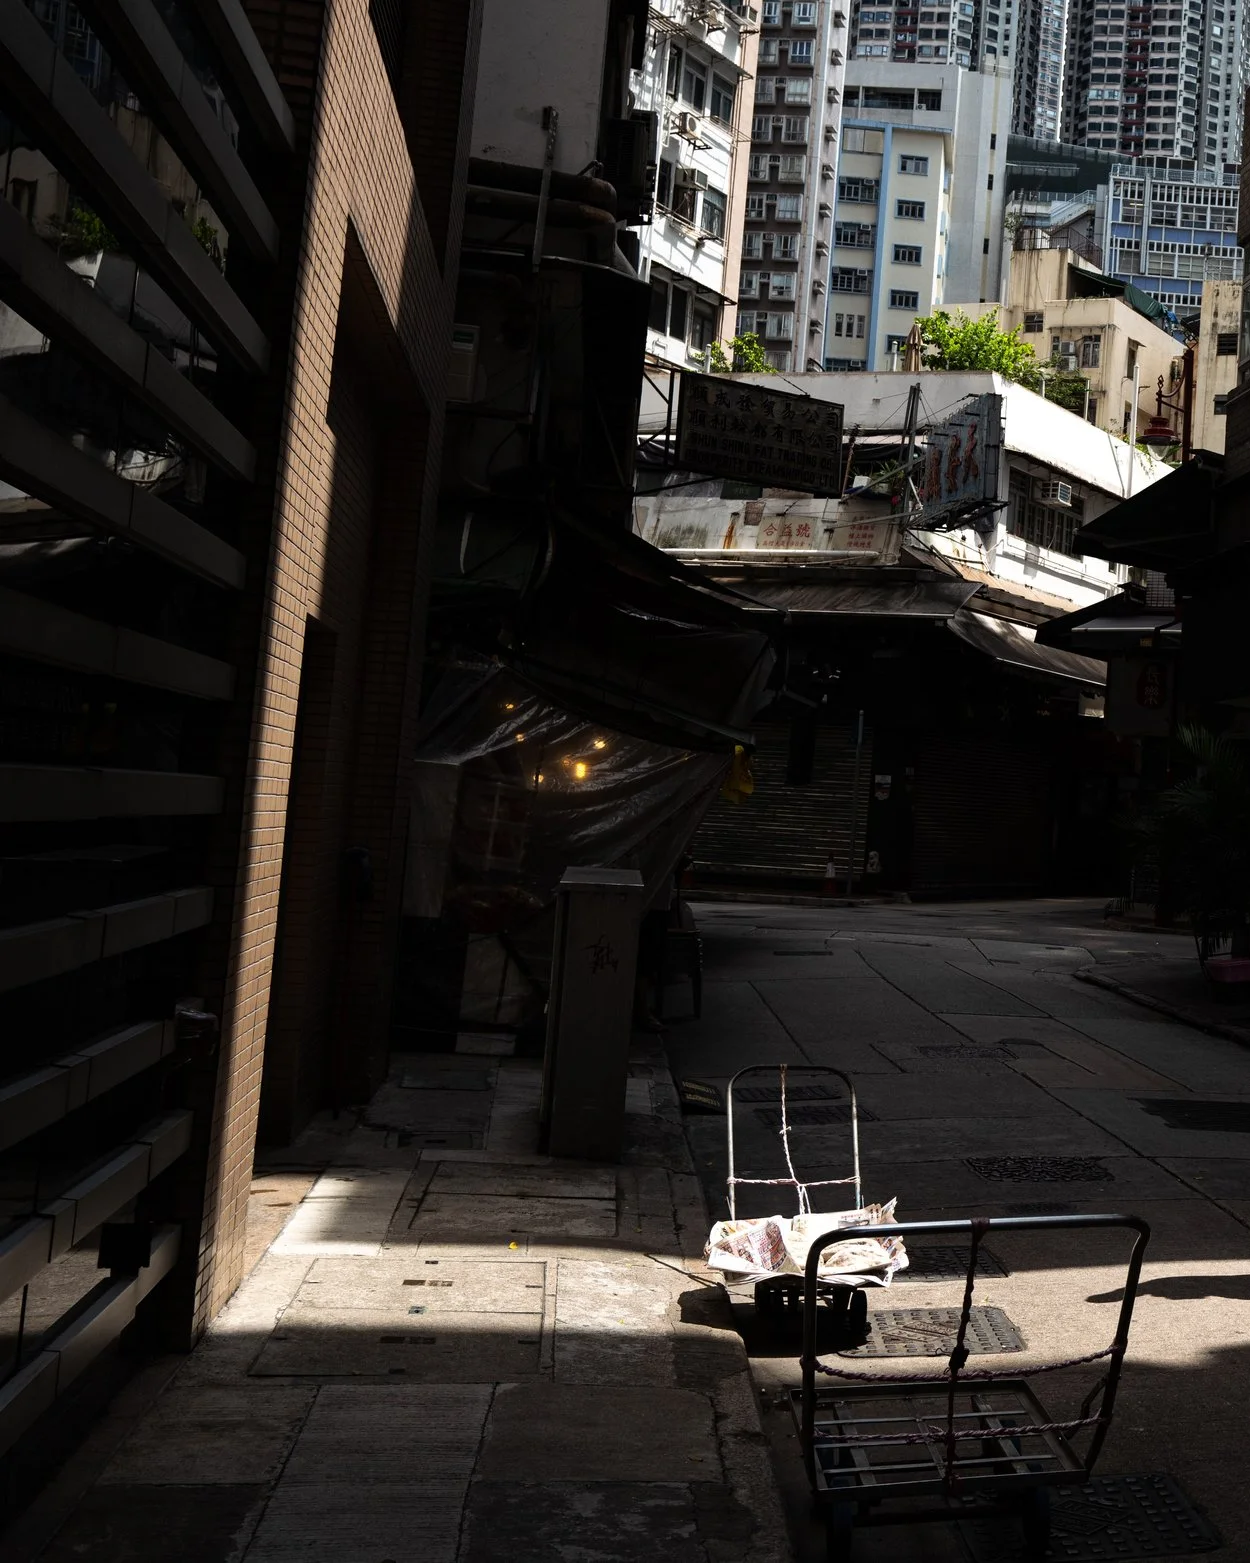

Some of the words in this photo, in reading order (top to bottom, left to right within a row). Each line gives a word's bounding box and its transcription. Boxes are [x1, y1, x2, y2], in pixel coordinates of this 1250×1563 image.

[722, 437, 750, 455] SHING
[755, 443, 773, 460] FAT
[778, 448, 817, 468] TRADING
[763, 522, 811, 539] 合益號
